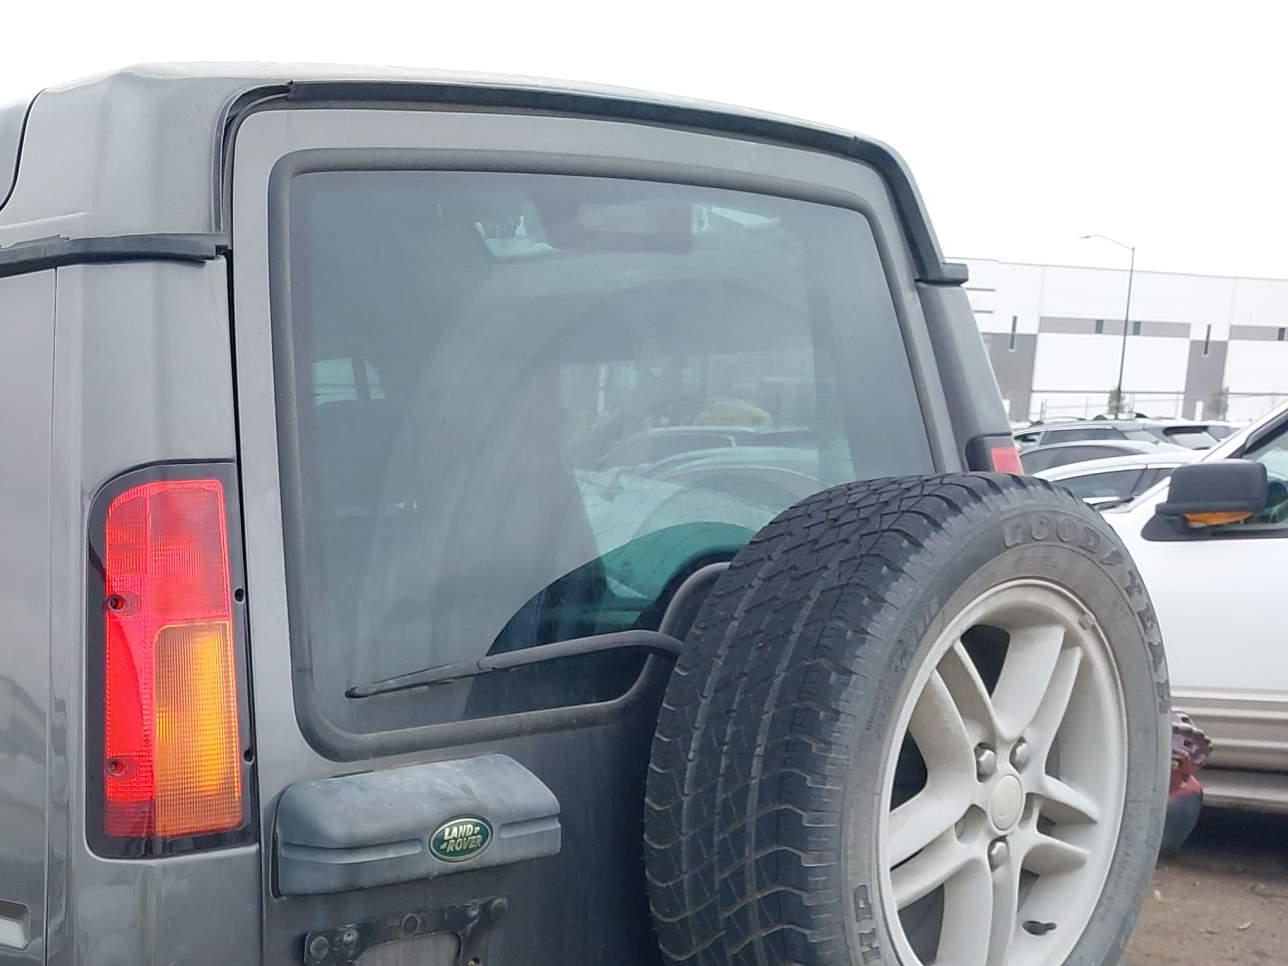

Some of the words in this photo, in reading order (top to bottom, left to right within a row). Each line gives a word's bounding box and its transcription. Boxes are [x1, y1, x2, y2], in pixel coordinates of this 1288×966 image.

[444, 824, 474, 840] LAND
[446, 834, 483, 853] ROVER
[853, 884, 881, 966] HP
